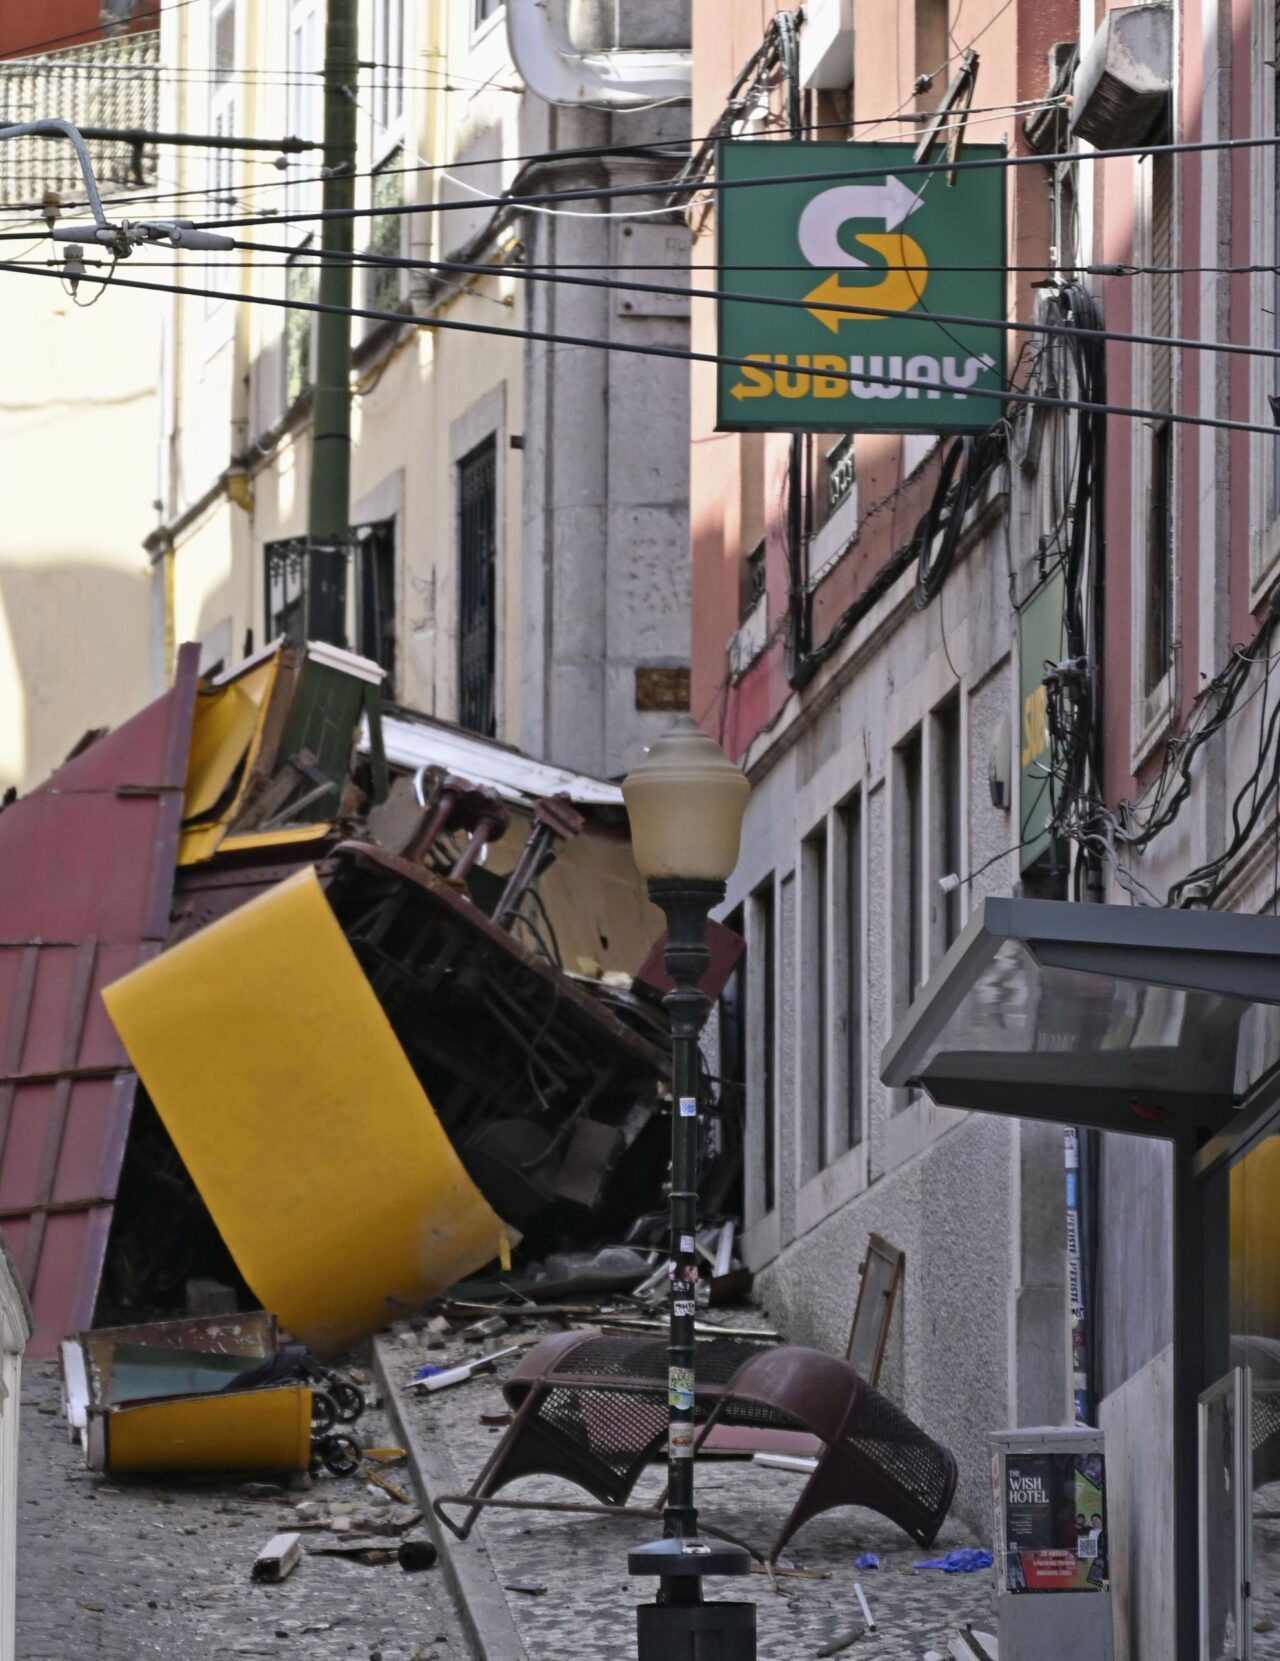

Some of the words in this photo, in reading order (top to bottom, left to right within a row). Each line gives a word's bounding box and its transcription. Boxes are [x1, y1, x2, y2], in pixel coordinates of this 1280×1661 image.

[730, 352, 996, 400] SUBWAY
[1009, 1477, 1042, 1490] WISH
[1009, 1490, 1050, 1503] HOTEL
